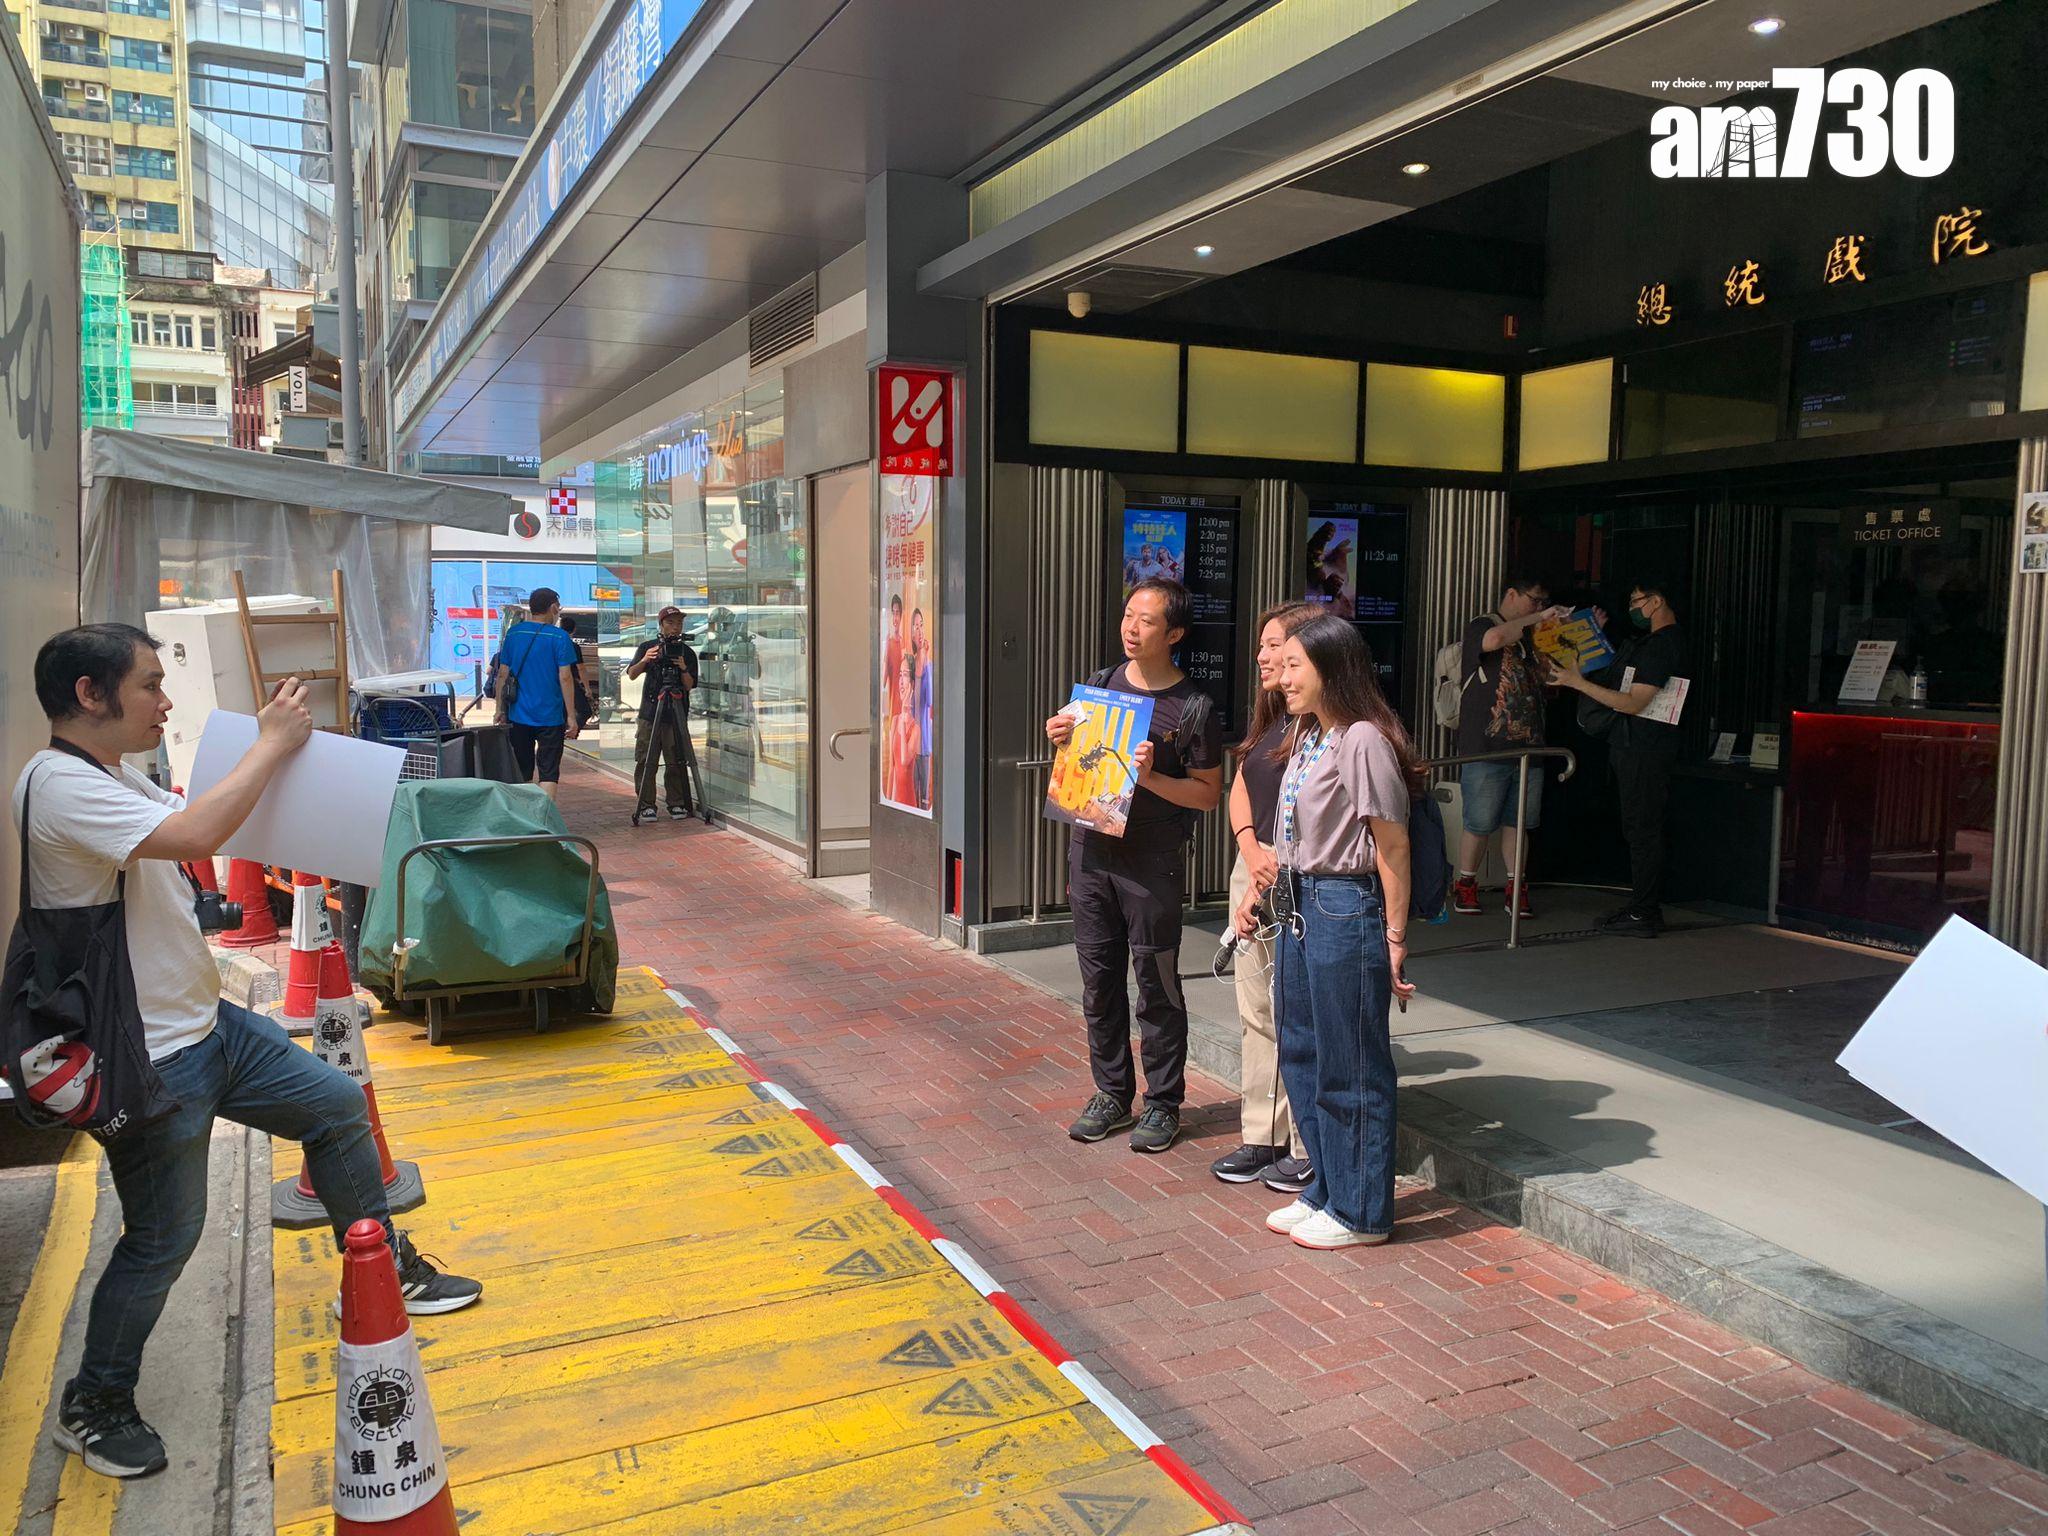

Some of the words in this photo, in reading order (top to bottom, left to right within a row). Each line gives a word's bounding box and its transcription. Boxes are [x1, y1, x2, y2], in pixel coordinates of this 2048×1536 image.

[1636, 206, 1989, 325] 總統戲院
[648, 429, 708, 484] mannings
[1161, 496, 1187, 505] TODAY
[1199, 517, 1218, 527] 12:00
[1219, 519, 1230, 528] pm
[1200, 531, 1215, 540] 2:20
[1216, 532, 1228, 541] pm
[1854, 529, 1892, 541] TICKET
[1897, 526, 1942, 540] OFFICE
[1199, 543, 1215, 553] 3:15
[1215, 545, 1227, 555] pm
[1364, 550, 1385, 561] 11:25
[1386, 552, 1399, 561] am
[1198, 557, 1214, 567] 5:05
[1214, 558, 1227, 568] pm
[1198, 570, 1213, 579] 7:25
[1214, 571, 1226, 580] pm
[1190, 652, 1208, 663] 1:30
[1210, 654, 1224, 664] pm
[1189, 668, 1207, 679] 7:35
[1209, 670, 1223, 680] pm
[1380, 664, 1392, 674] pm
[342, 1069, 363, 1078] HIN
[346, 1364, 415, 1409] hongkong
[349, 1403, 416, 1442] electric
[339, 1481, 396, 1500] CHUNG
[400, 1462, 436, 1492] CHIN
